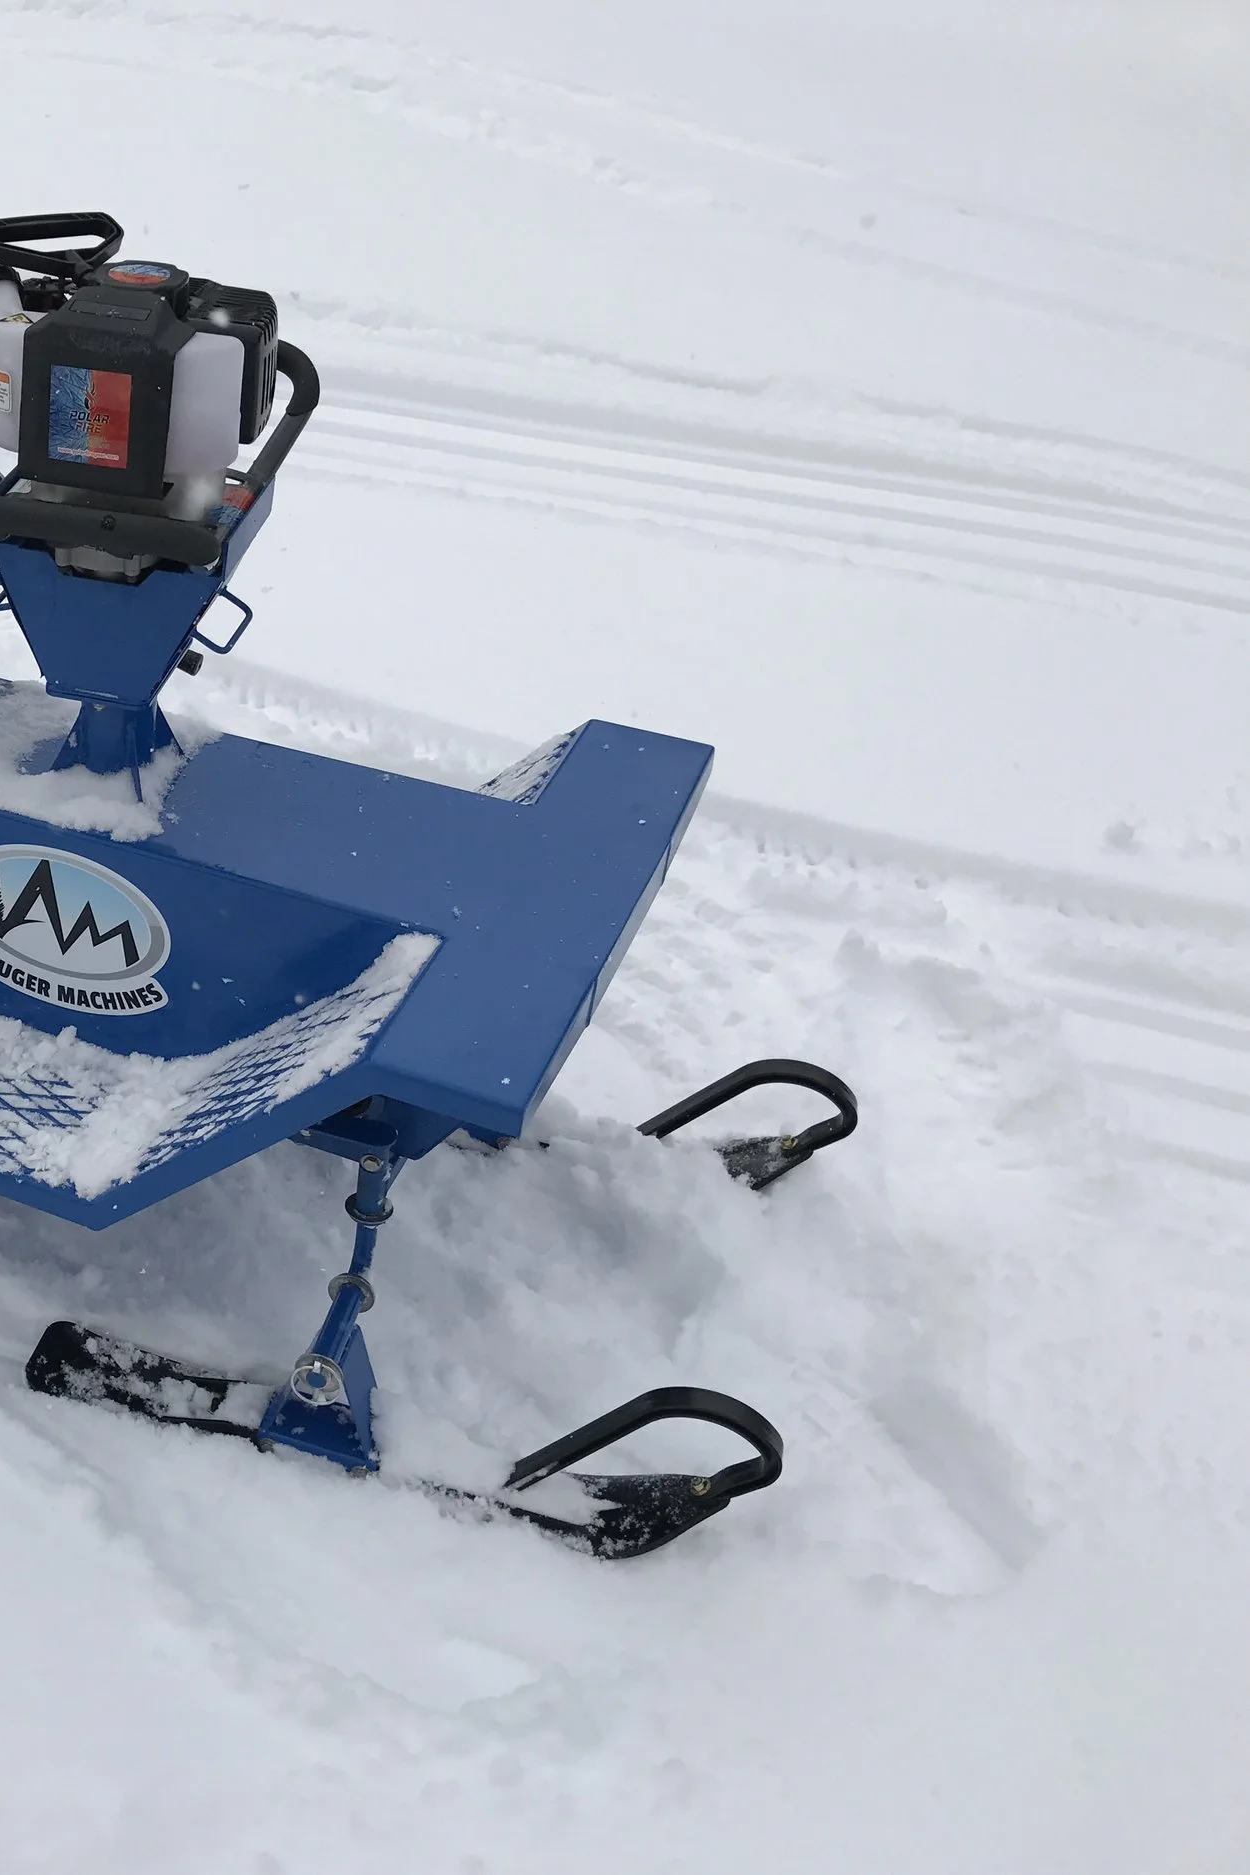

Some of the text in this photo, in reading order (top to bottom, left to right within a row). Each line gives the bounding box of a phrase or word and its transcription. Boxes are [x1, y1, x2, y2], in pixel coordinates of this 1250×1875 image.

[70, 410, 110, 424] POLAR
[75, 421, 102, 433] FIRE
[57, 982, 164, 1011] MACHINES
